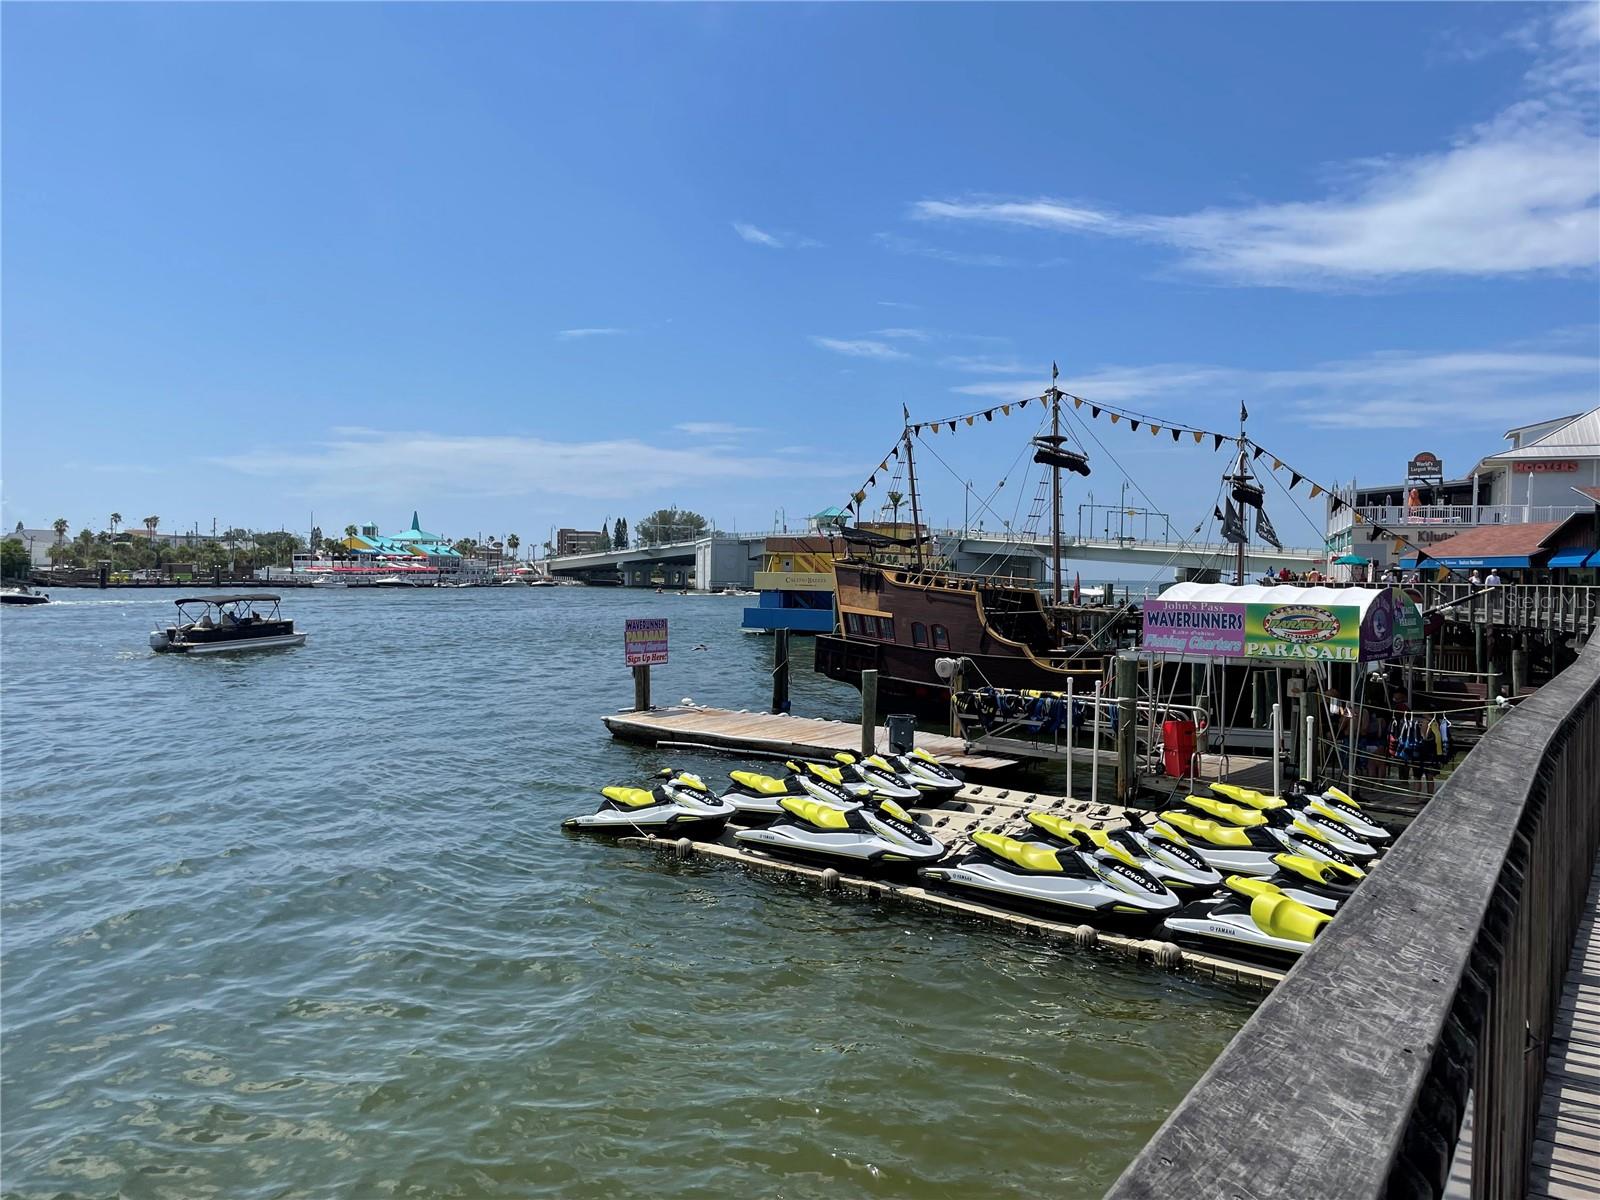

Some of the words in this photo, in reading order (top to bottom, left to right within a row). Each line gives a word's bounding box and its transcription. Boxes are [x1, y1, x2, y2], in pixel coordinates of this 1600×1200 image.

[1513, 462, 1578, 472] HOOTERS
[1163, 602, 1197, 610] John's
[1201, 602, 1224, 611] Pass
[1147, 611, 1243, 630] WAVERUNNERS
[1189, 635, 1242, 652] Charters
[1247, 643, 1358, 661] PARASAIL
[627, 654, 641, 664] Sign
[642, 654, 651, 663] Up
[1190, 858, 1203, 868] SX
[1145, 882, 1159, 892] SX
[1215, 927, 1236, 936] YAMAHA
